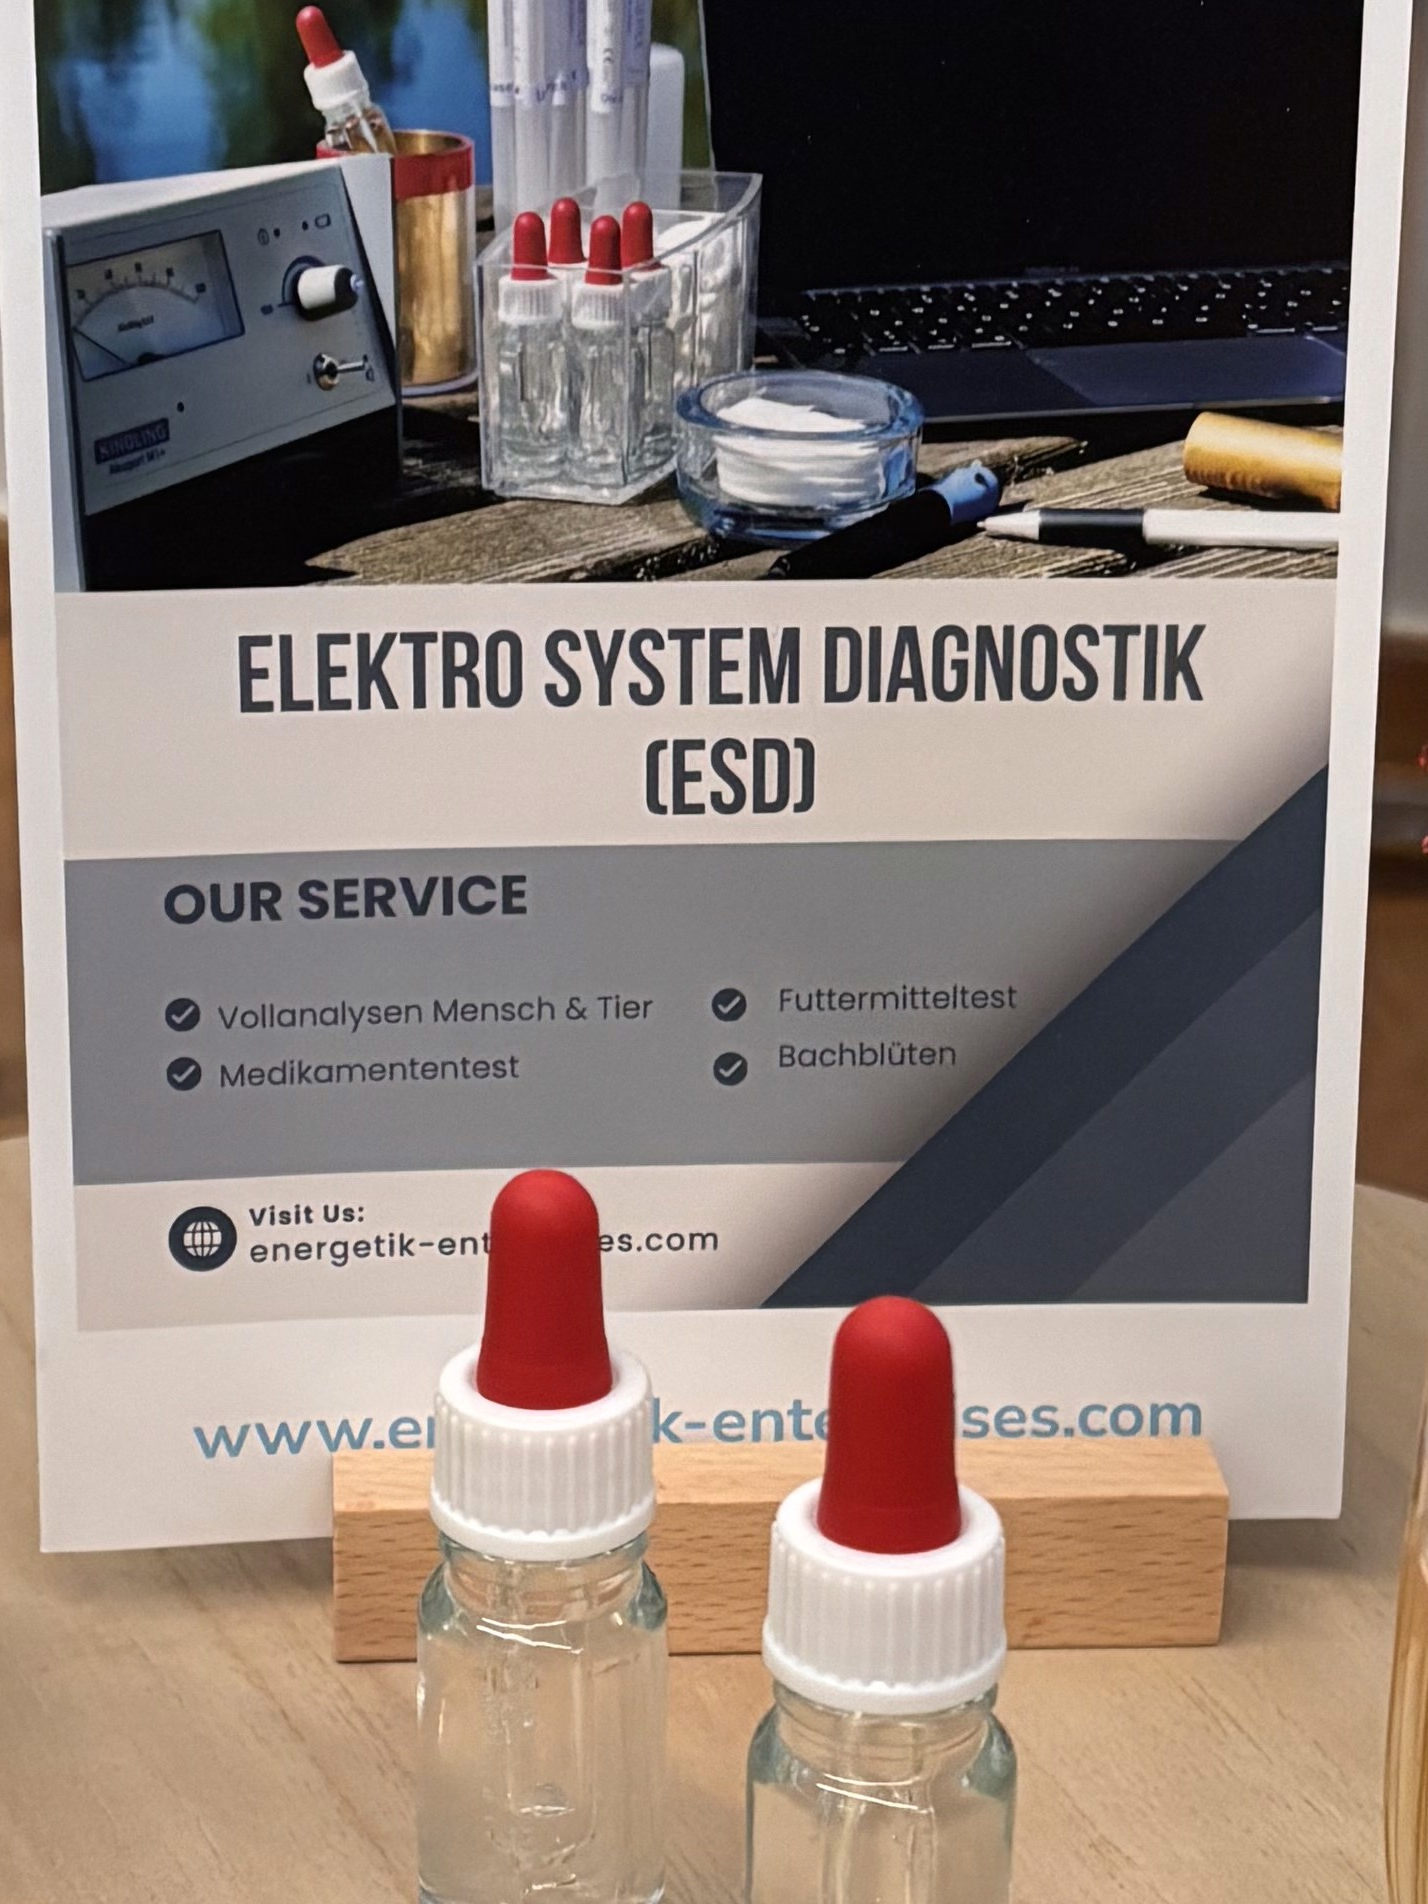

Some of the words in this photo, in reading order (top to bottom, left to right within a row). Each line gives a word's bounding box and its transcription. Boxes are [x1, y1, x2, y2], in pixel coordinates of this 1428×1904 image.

[237, 629, 523, 714] ELEKTRO
[543, 626, 801, 708] SYSTEM
[823, 623, 1207, 704] DIAGNOSTIK
[645, 737, 816, 816] (ESD)
[164, 881, 283, 925] OUR
[298, 874, 528, 920] SERVICE
[217, 1000, 423, 1034] Vollanalysen
[433, 995, 556, 1024] Mensch
[565, 996, 588, 1022] &
[597, 994, 654, 1021] Tier
[778, 983, 1018, 1014] Futtermitteltest
[219, 1054, 520, 1089] Medikamententest
[778, 1041, 957, 1070] Bachblüten
[248, 1203, 315, 1227] Visit
[322, 1203, 365, 1224] Us:
[249, 1231, 719, 1267] energetik-entes.com
